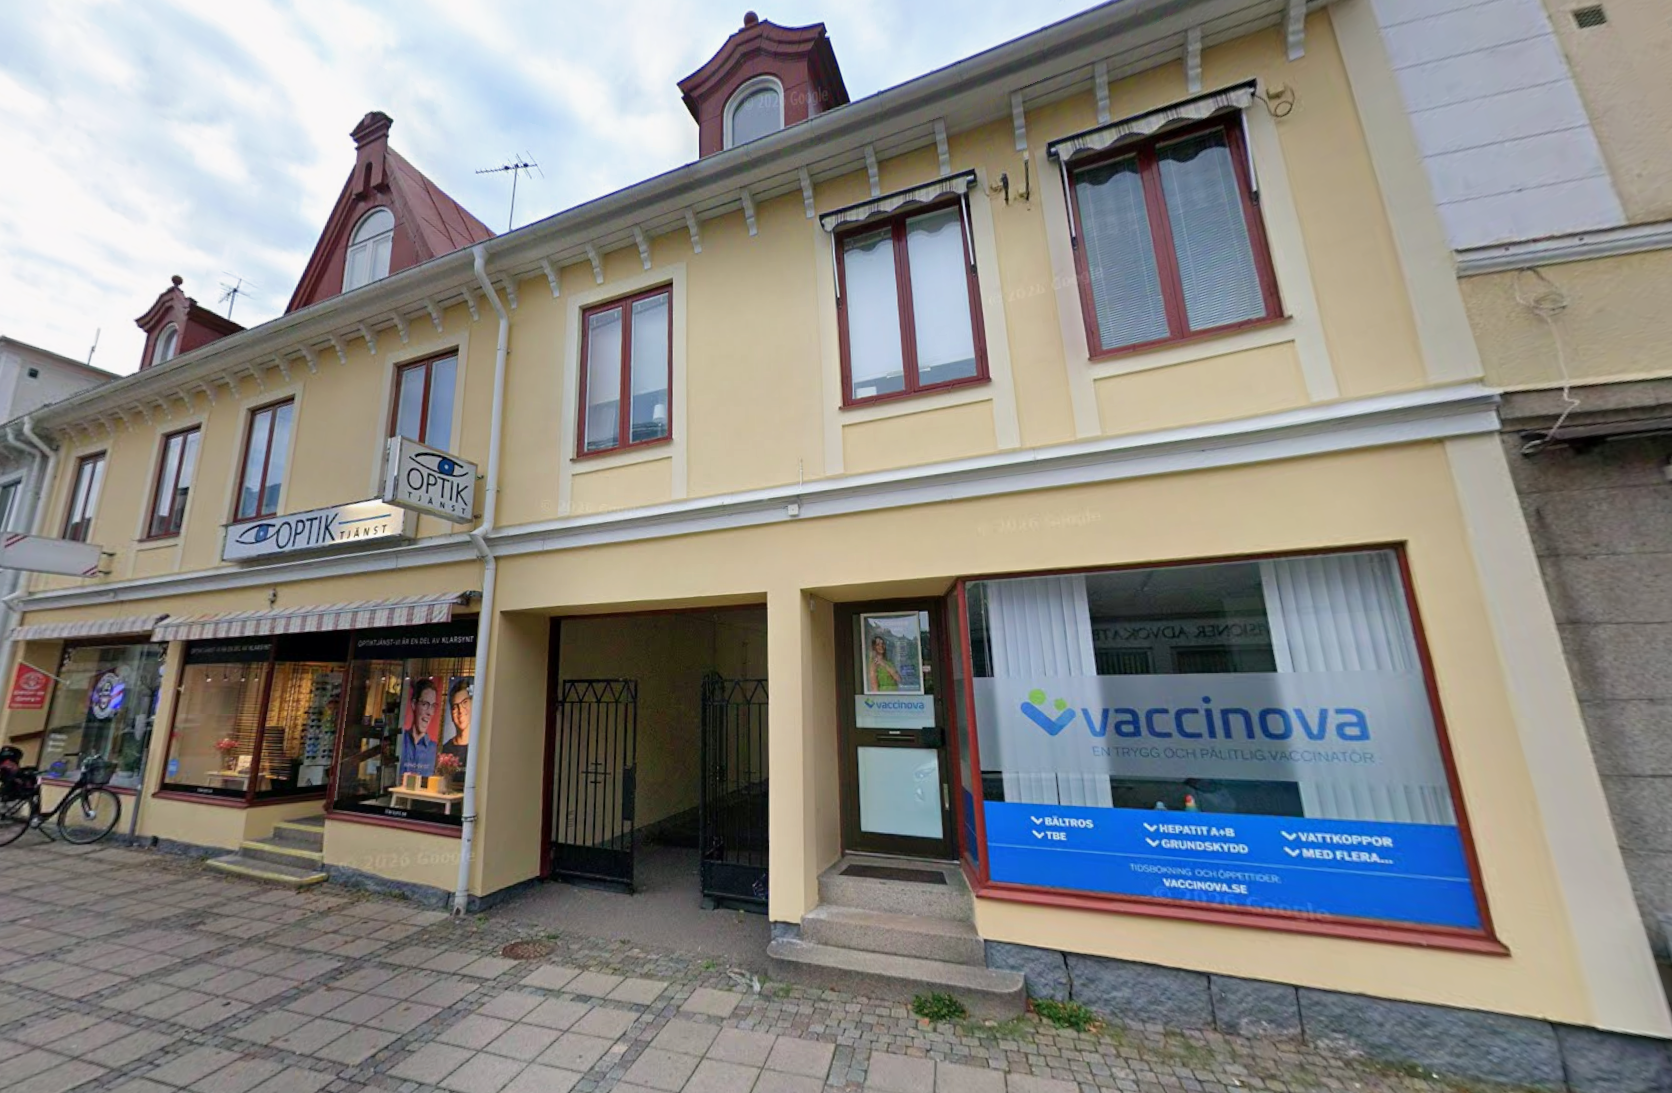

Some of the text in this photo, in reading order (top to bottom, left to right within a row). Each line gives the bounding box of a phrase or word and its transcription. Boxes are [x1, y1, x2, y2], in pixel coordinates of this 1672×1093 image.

[407, 467, 469, 506] OPTIK
[407, 490, 467, 514] TJÄNST
[275, 512, 388, 549] OPTIK TJÄNST
[875, 699, 925, 710] vaccinova
[1081, 696, 1371, 741] vaccinova
[1092, 745, 1111, 757] EN
[1112, 746, 1160, 759] TRYGG
[1163, 747, 1197, 760] OCH
[1200, 746, 1267, 761] PÅLITLIG
[1044, 815, 1094, 829] BÄLTROS
[1046, 831, 1067, 841] TBE
[1159, 824, 1236, 838] HEPATIT A+B
[1161, 838, 1249, 855] GRUNDSKYDD
[1298, 832, 1394, 848] VATTKOPPOR
[1302, 848, 1394, 865] MED FLERA...
[1129, 862, 1192, 877] TIDSBOKNING
[1195, 868, 1217, 878] OCH
[1162, 877, 1248, 895] VACCINOVA.SE
